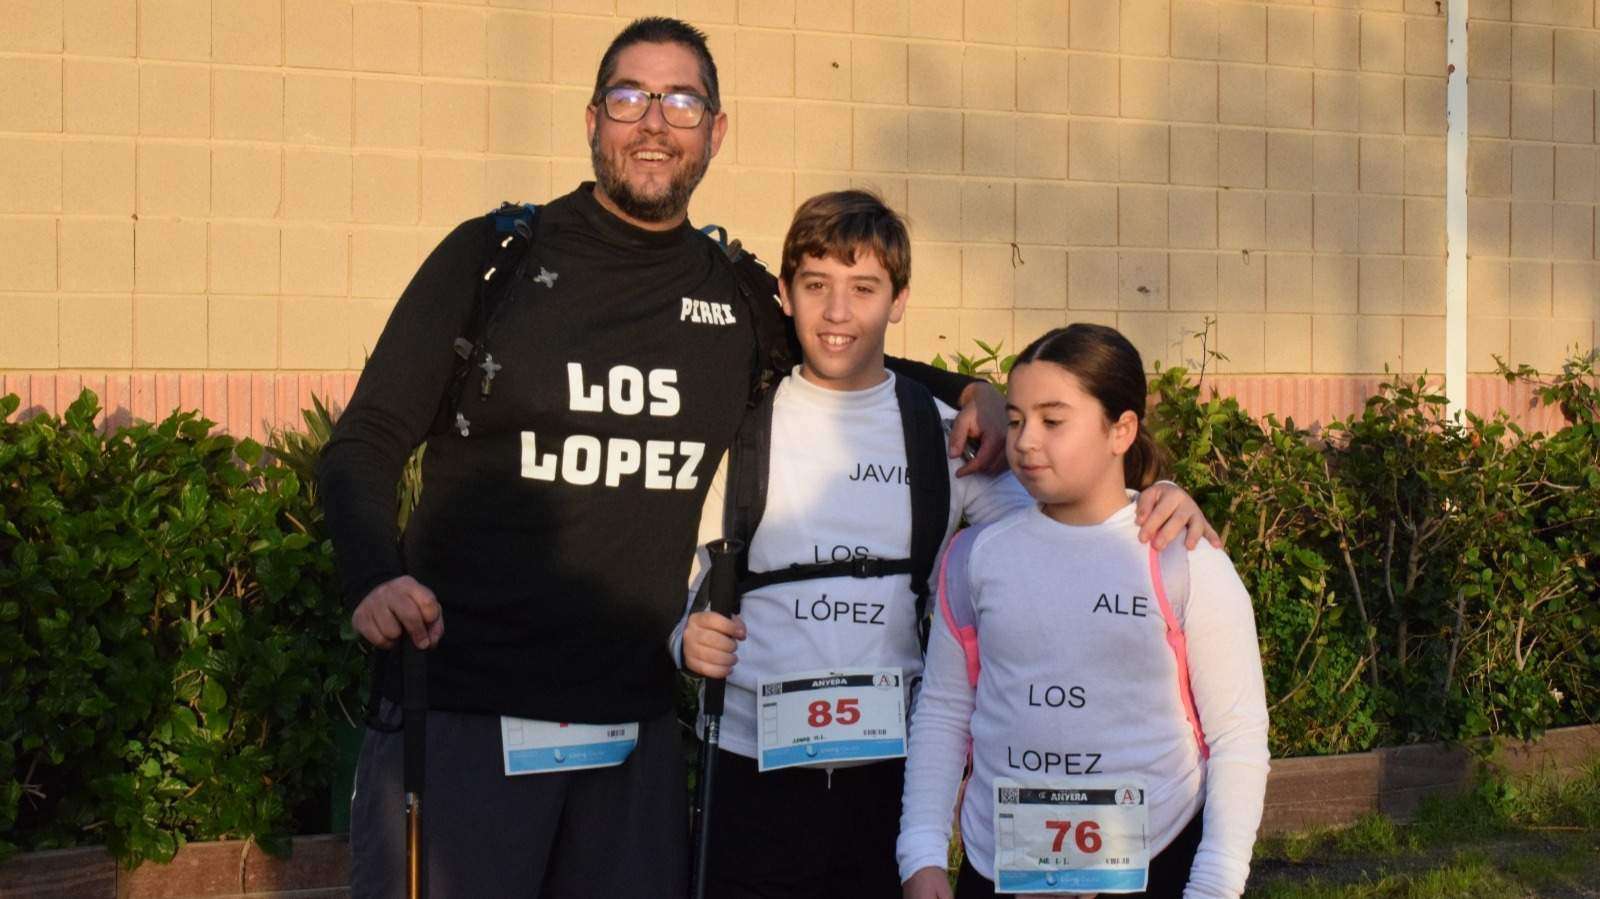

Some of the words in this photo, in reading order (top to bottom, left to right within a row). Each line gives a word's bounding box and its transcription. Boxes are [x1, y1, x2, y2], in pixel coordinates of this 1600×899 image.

[681, 297, 736, 326] PIRRI
[567, 362, 681, 417] LOS
[521, 431, 706, 490] LOPEZ
[795, 594, 885, 625] LÓPEZ
[1093, 593, 1148, 617] ALE
[1028, 684, 1086, 709] LOS
[807, 698, 861, 728] 85
[1008, 746, 1102, 776] LOPEZ
[1045, 820, 1103, 854] 76
